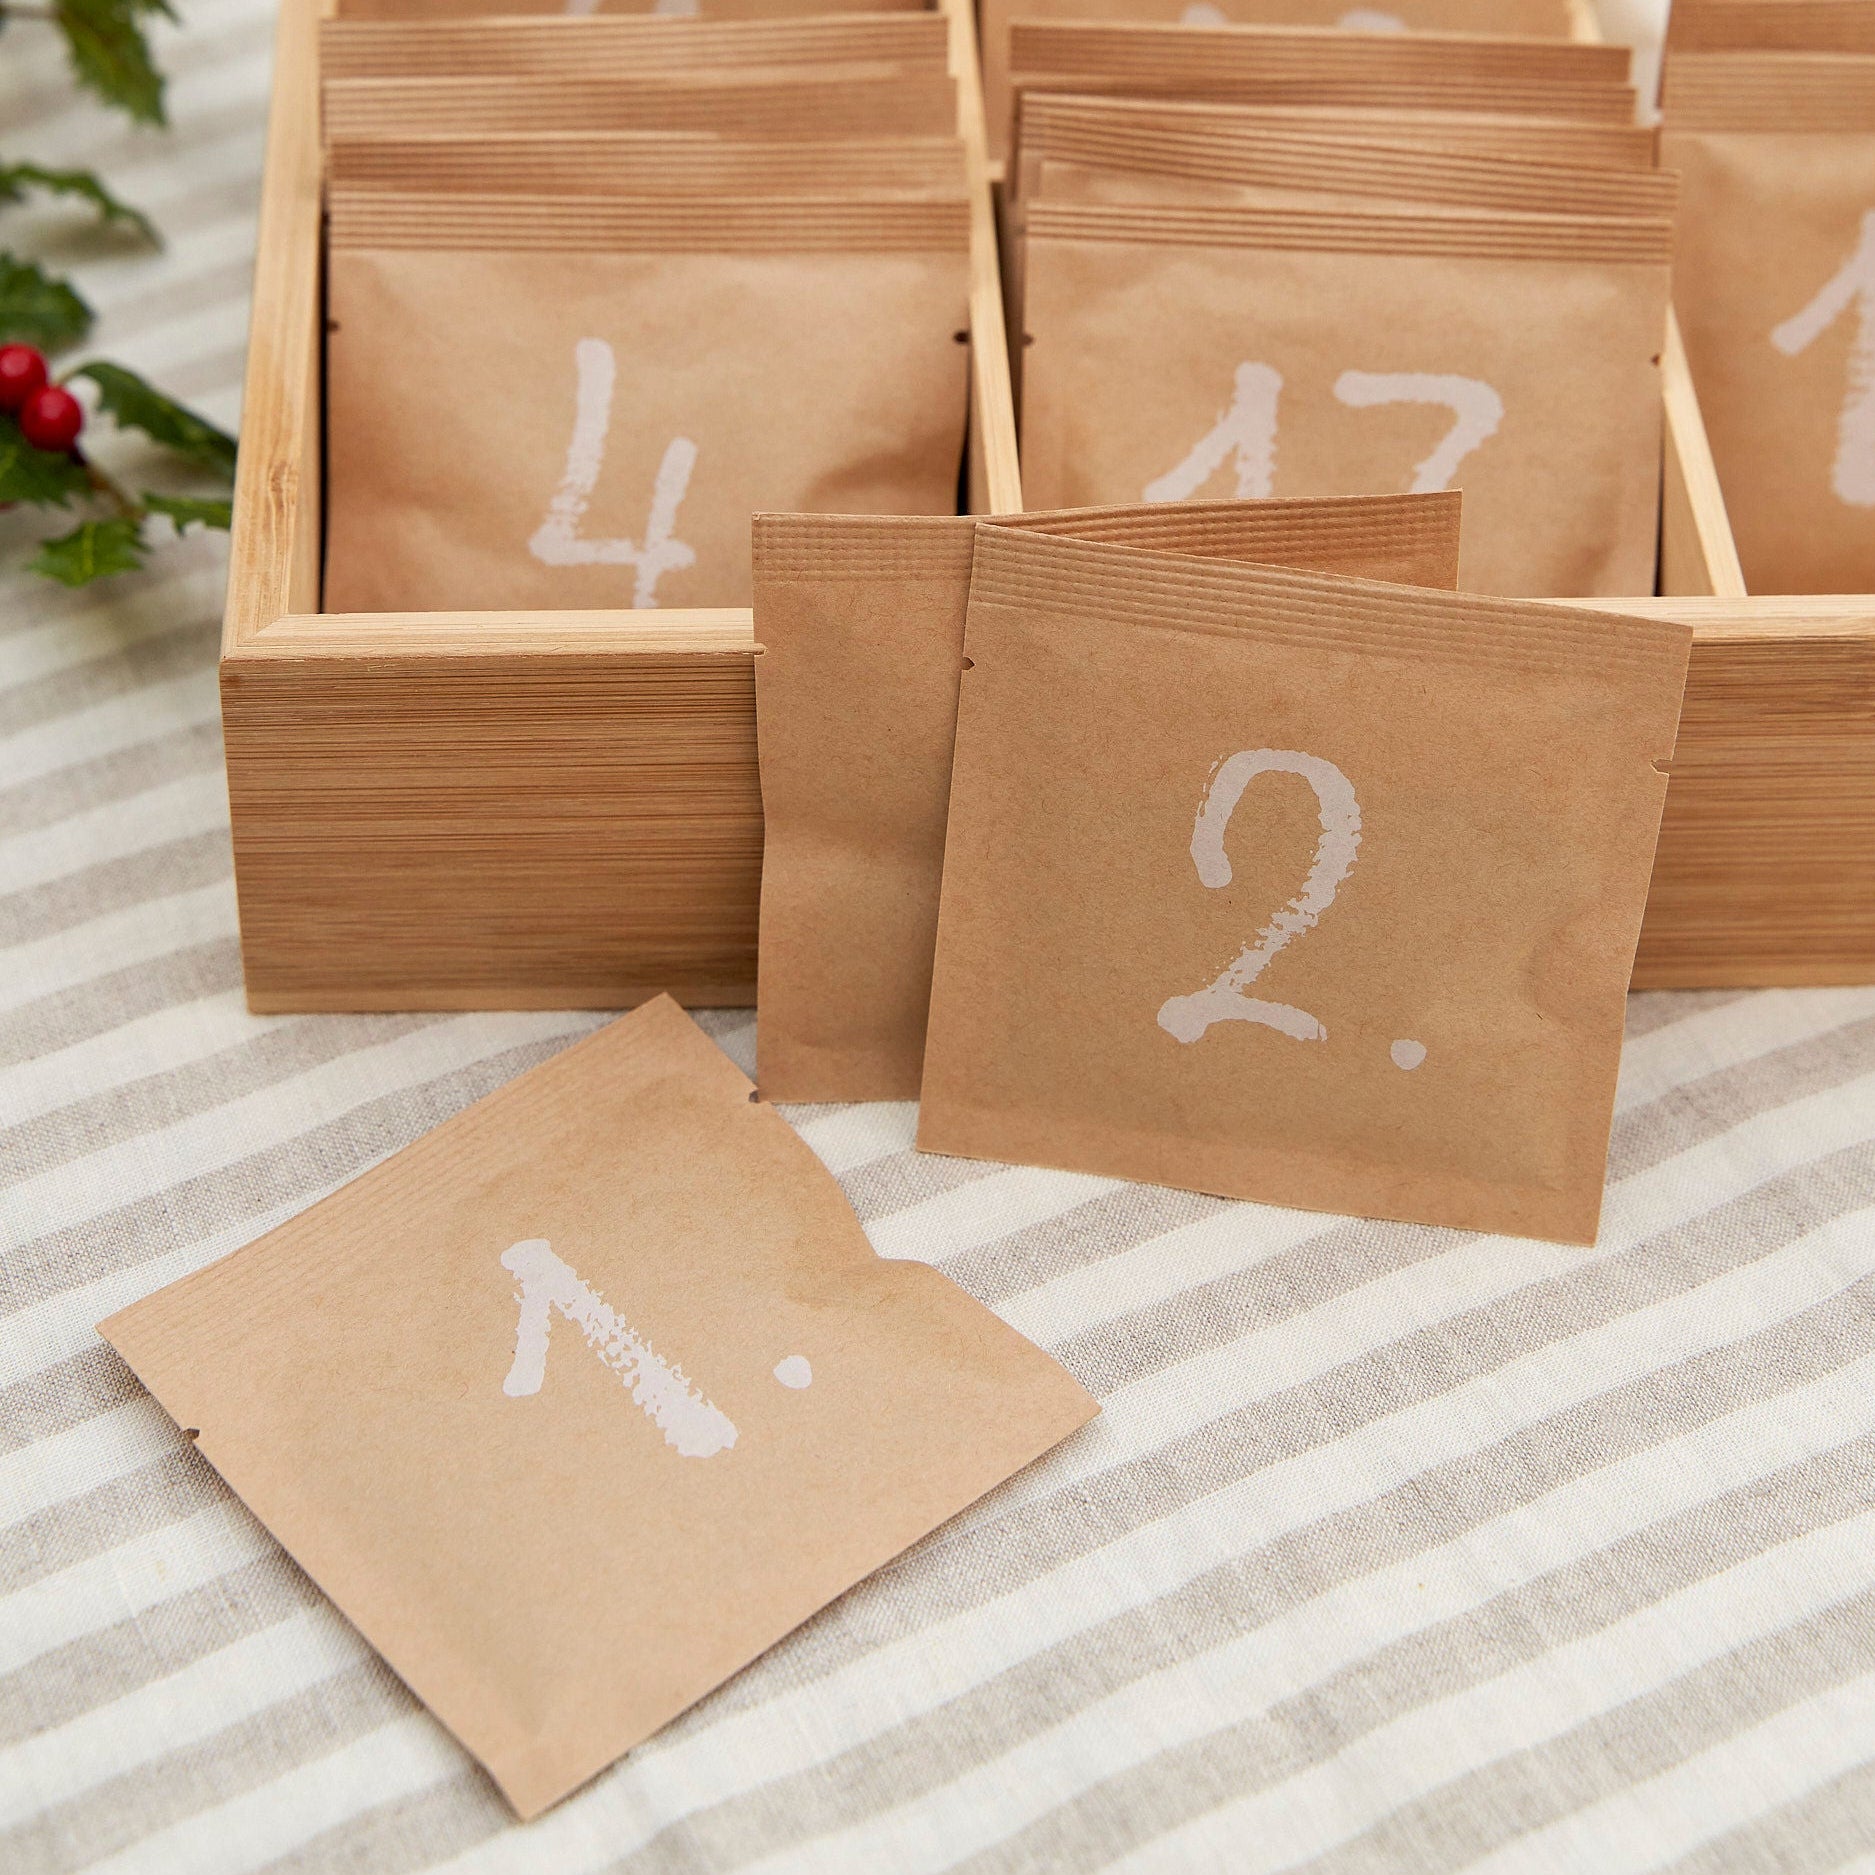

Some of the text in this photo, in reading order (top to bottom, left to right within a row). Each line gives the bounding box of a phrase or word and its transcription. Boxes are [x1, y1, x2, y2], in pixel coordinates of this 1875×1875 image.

[528, 337, 697, 608] 4
[1157, 748, 1427, 1070] 2.
[500, 1238, 813, 1458] 1.
